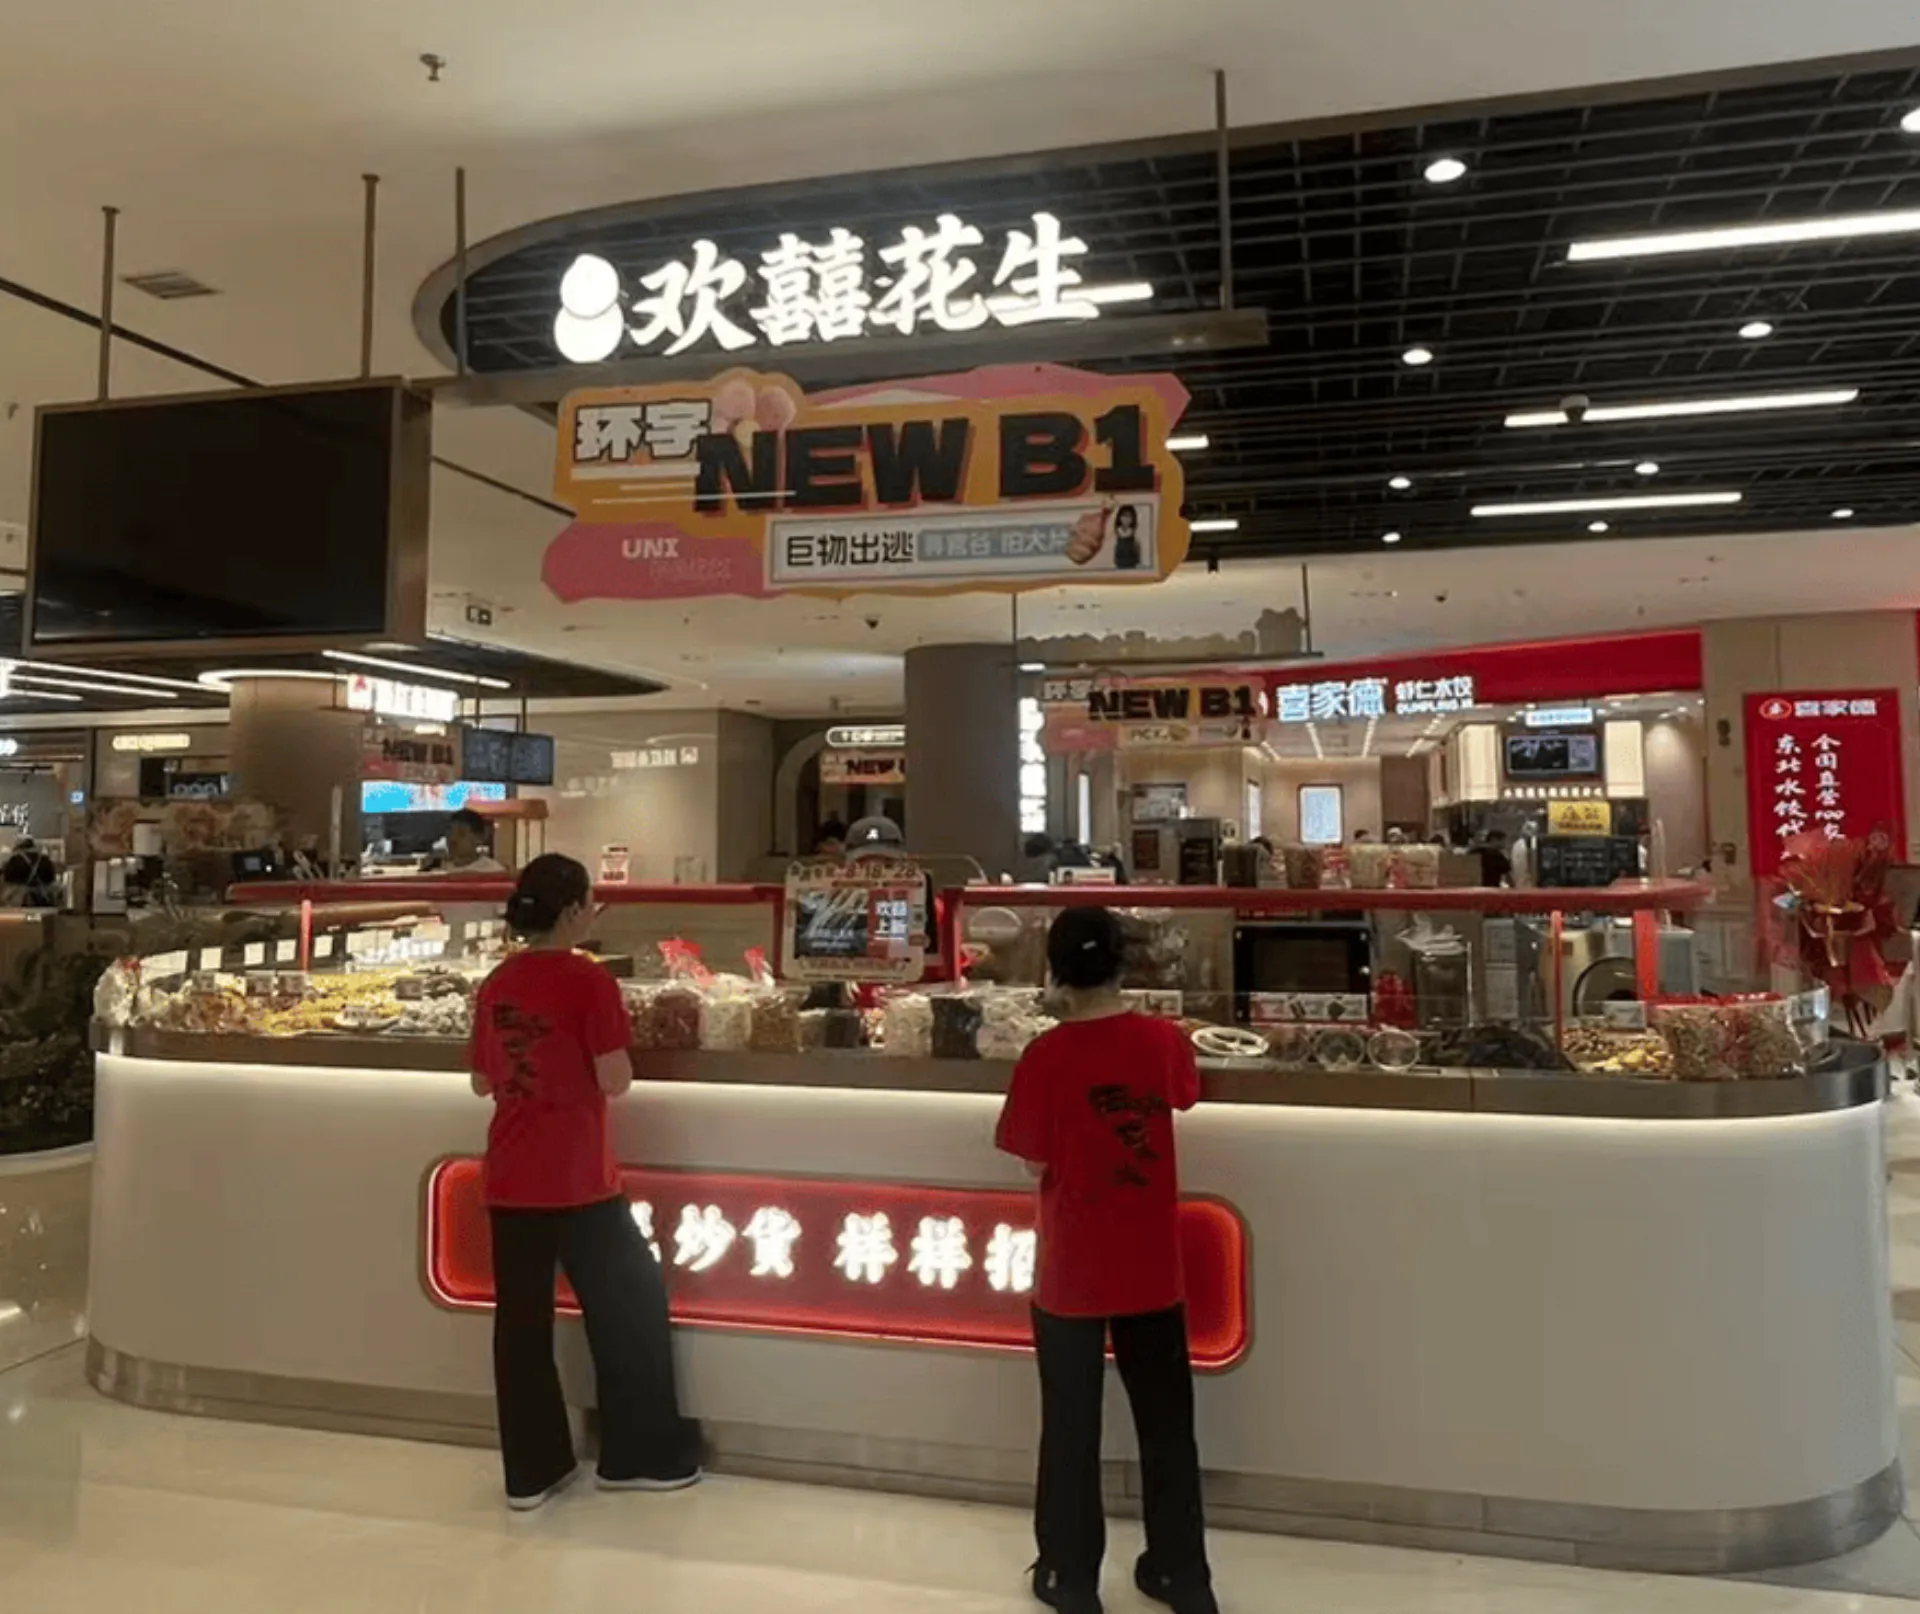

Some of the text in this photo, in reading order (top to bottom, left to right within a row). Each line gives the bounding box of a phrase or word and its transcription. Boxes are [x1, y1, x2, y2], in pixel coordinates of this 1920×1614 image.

[575, 400, 712, 462] 环宇
[693, 404, 1156, 514] NEW B1
[621, 538, 680, 559] UNI
[786, 531, 914, 567] 巨物出逃
[1088, 685, 1256, 720] NEW B1
[1276, 679, 1386, 721] 喜家德
